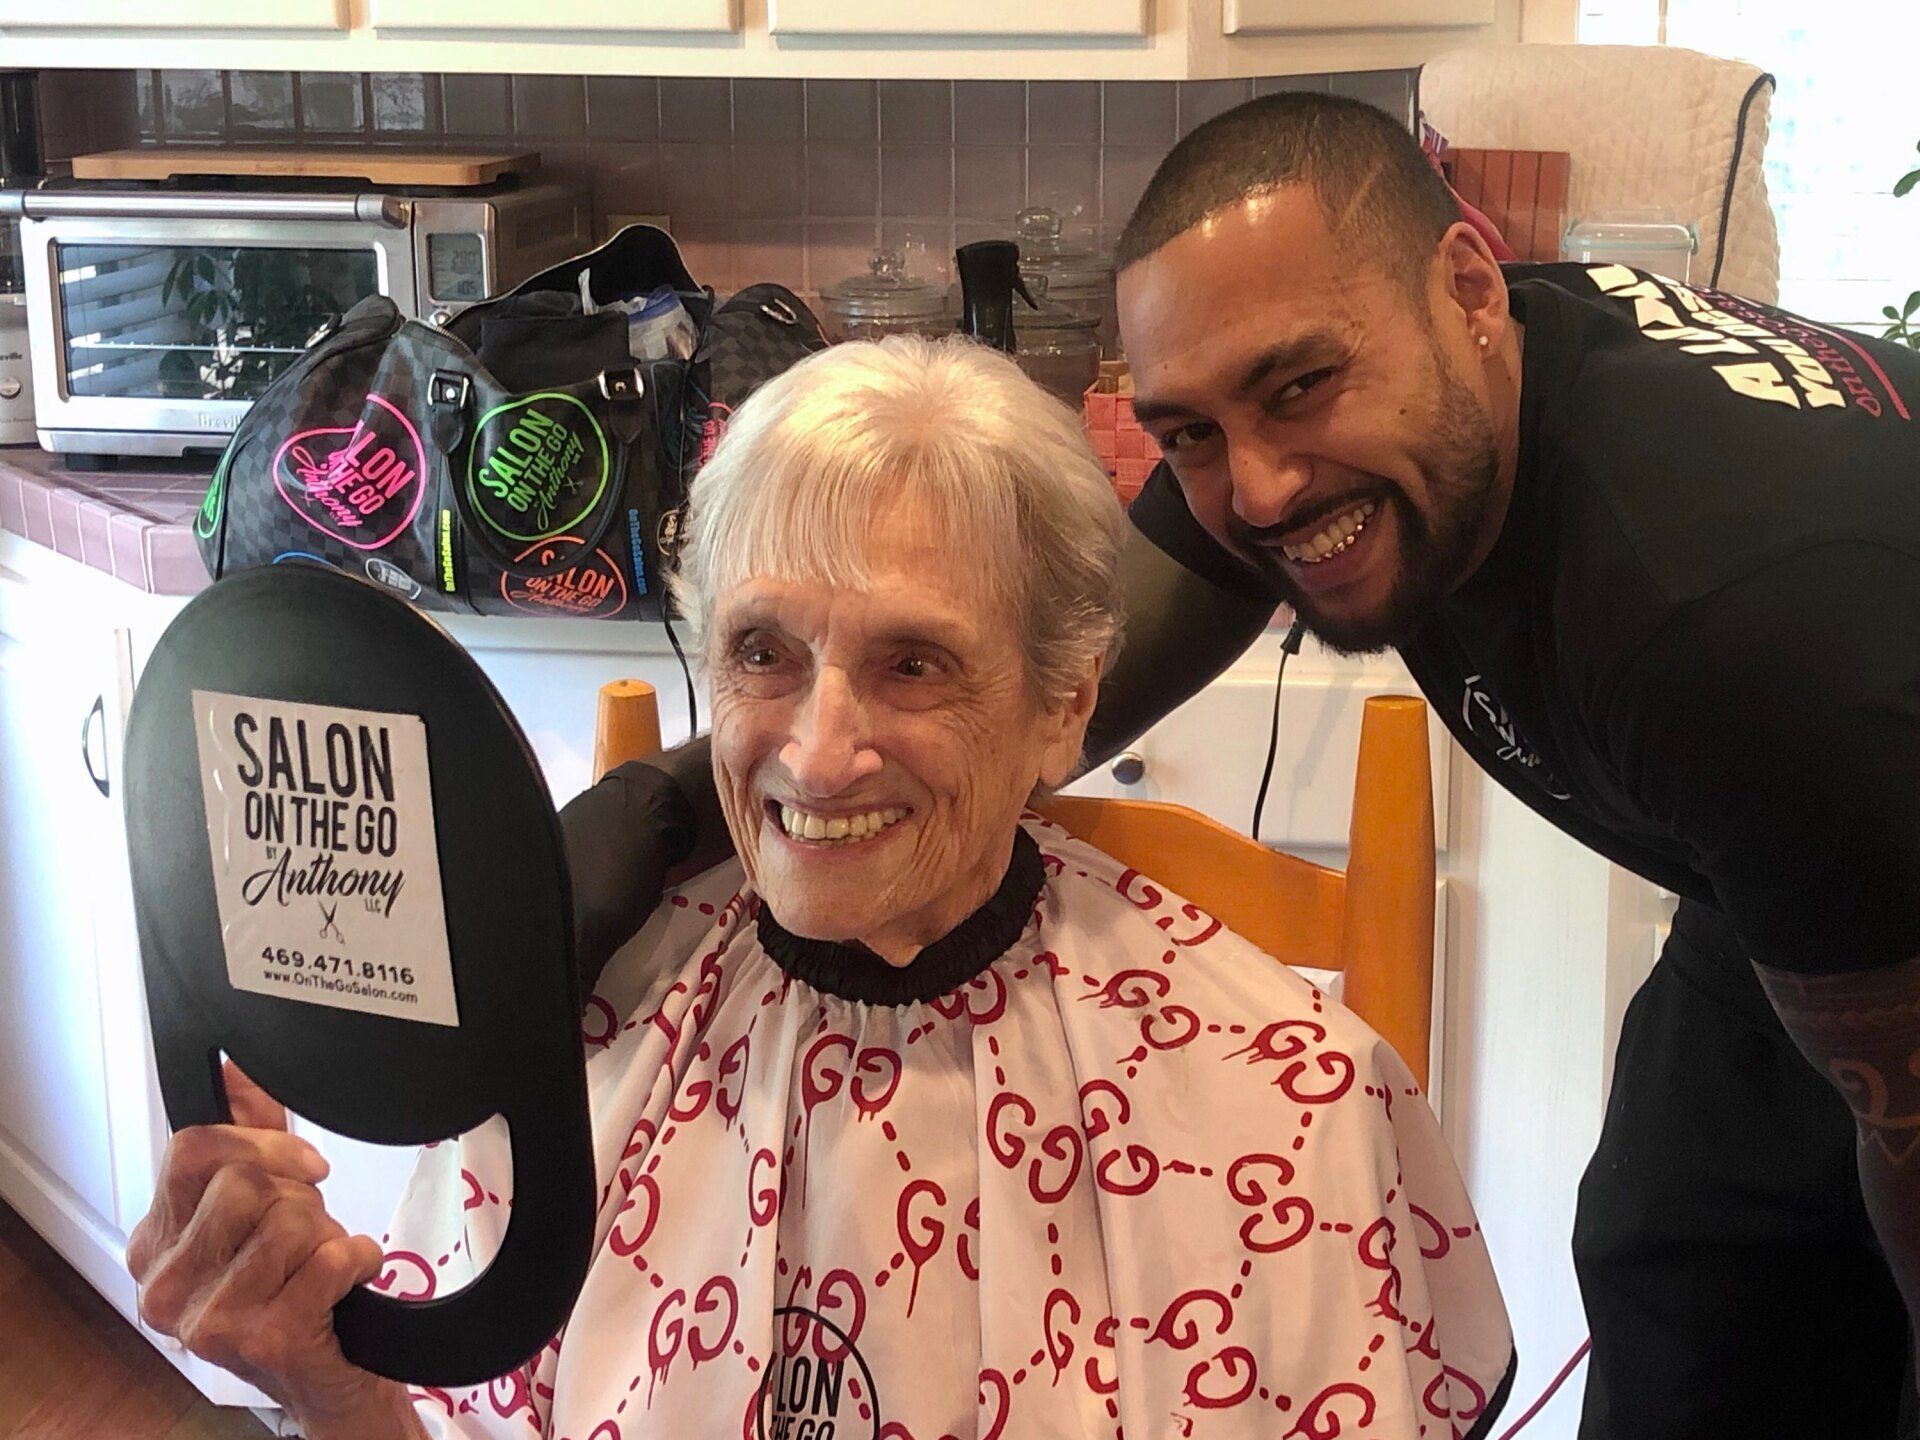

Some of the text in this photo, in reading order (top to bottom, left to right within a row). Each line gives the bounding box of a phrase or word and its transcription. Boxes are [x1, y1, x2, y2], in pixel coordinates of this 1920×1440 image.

[344, 431, 416, 499] LON
[478, 408, 554, 498] SALON
[507, 423, 568, 512] ON THE GO
[348, 484, 386, 515] GO
[234, 712, 395, 802] SALON
[244, 790, 398, 857] ON THE GO
[242, 846, 406, 919] Anthony
[261, 946, 415, 985] 469.471.8116
[263, 969, 419, 1004] www.OnTheGoSalon.com
[776, 1354, 845, 1417] LON
